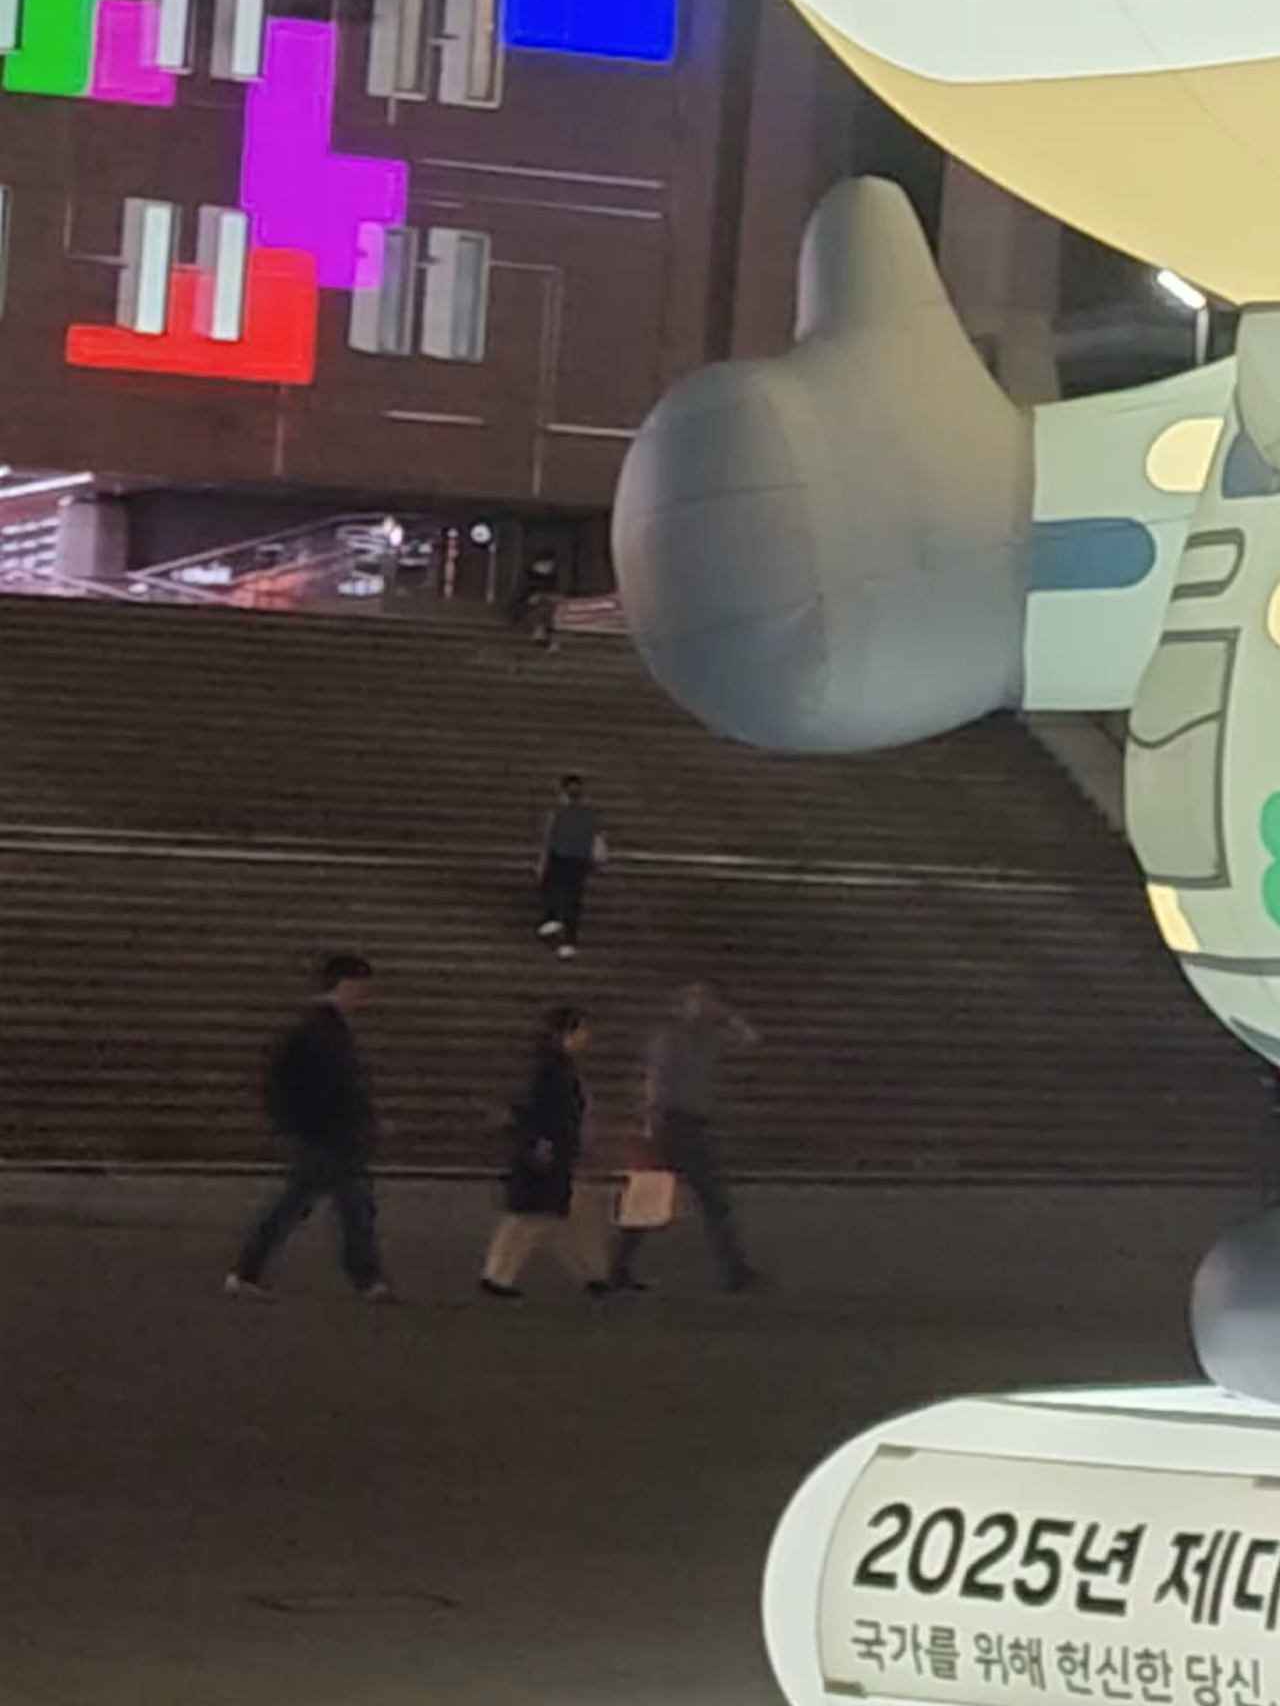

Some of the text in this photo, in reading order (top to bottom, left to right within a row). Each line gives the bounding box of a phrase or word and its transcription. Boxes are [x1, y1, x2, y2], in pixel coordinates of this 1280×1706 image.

[854, 1502, 1147, 1616] 2025년
[851, 1619, 962, 1682] 국가를
[972, 1632, 1046, 1694] 위해
[1055, 1639, 1174, 1705] 헌신한
